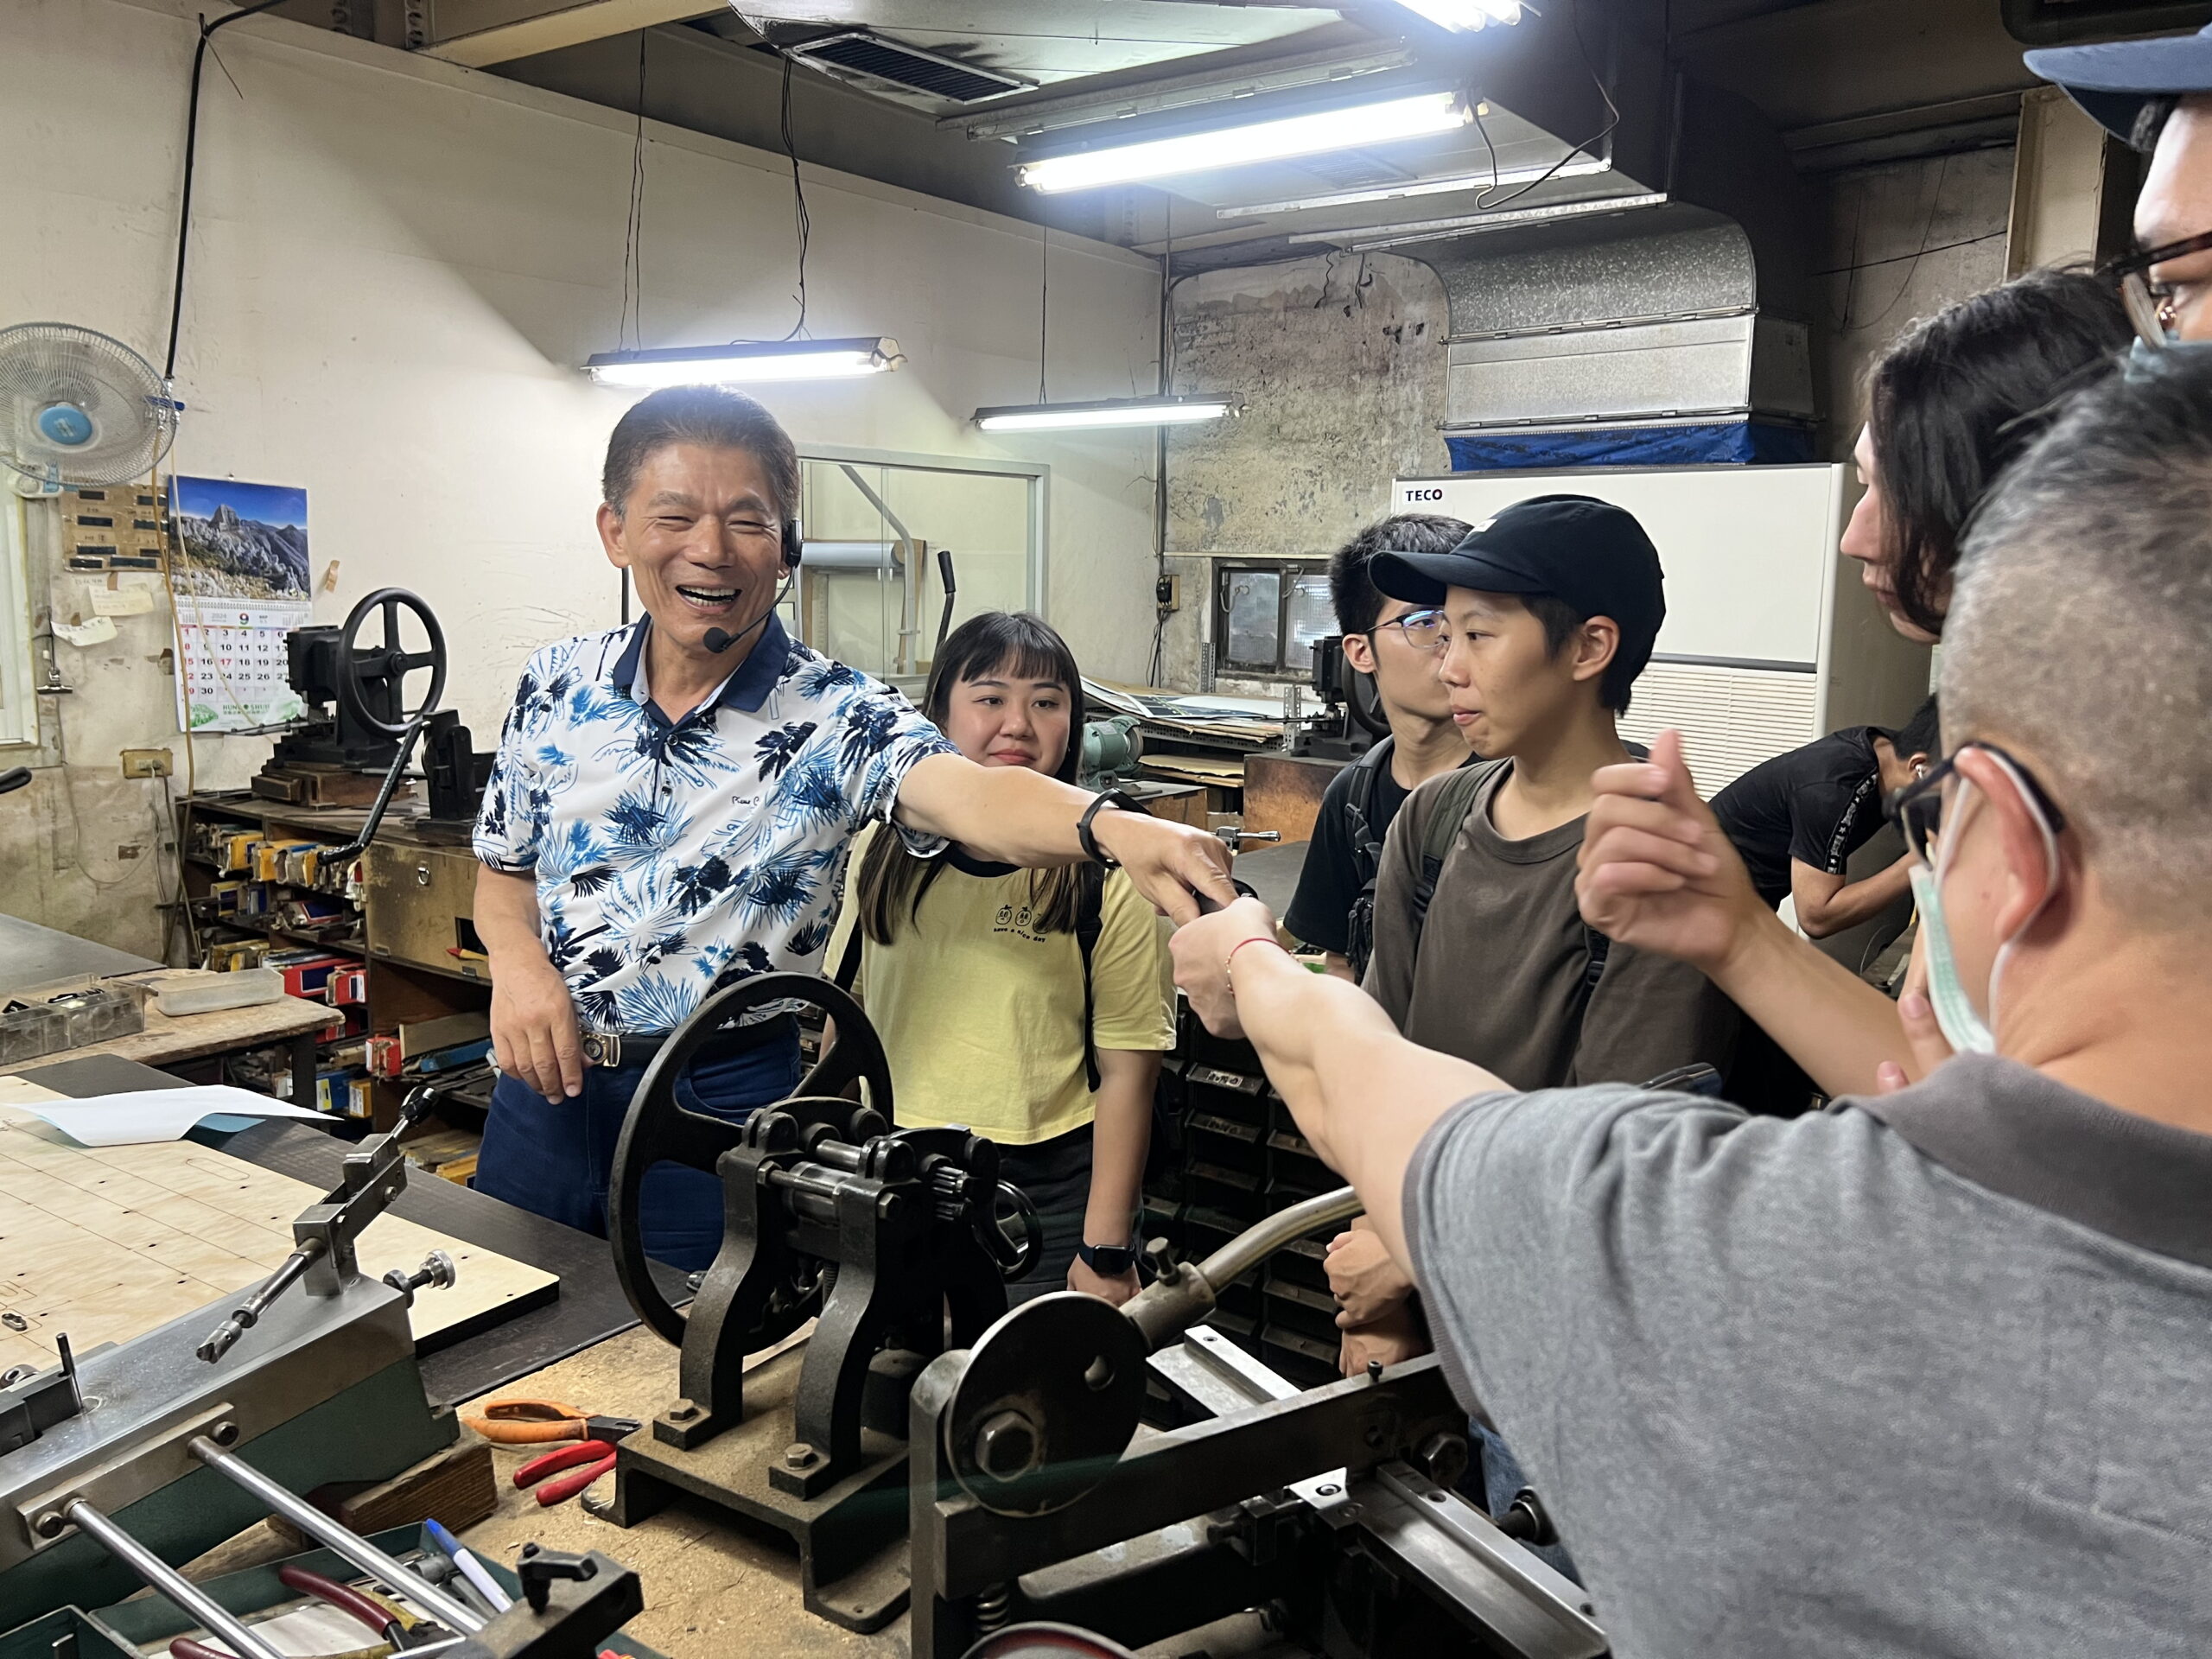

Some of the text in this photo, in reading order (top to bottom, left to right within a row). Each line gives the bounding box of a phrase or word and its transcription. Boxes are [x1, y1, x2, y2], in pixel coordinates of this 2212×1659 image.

[1406, 489, 1443, 501] TECO
[239, 613, 249, 625] 9
[1017, 931, 1030, 939] nice
